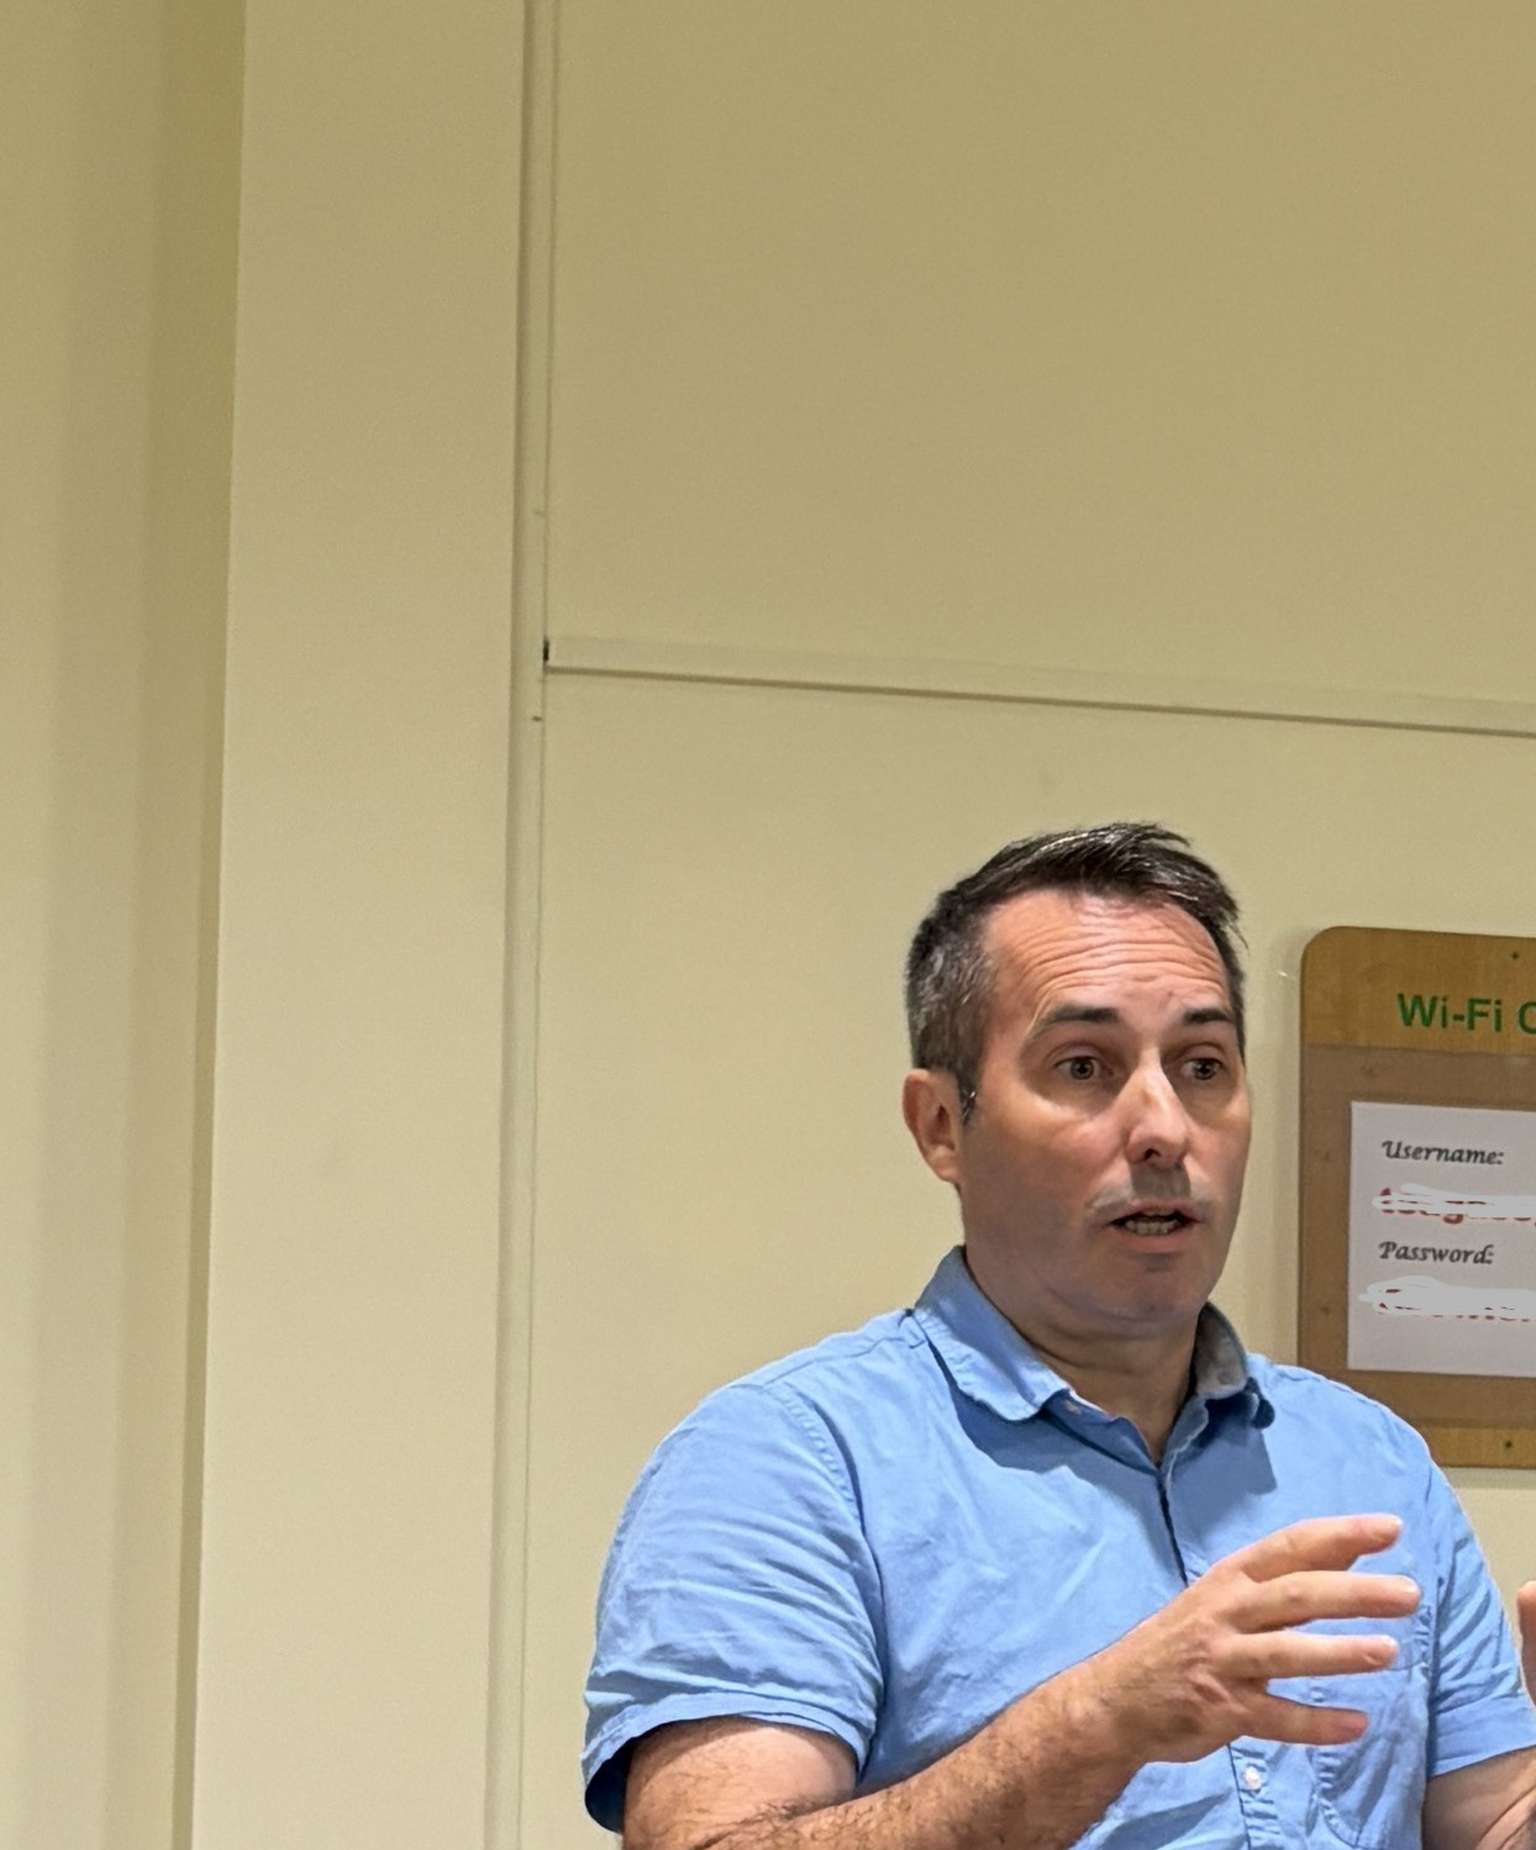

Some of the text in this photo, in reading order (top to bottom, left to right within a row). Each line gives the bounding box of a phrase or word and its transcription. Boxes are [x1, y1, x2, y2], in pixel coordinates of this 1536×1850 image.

[1397, 992, 1502, 1033] Wi-Fi
[1381, 1140, 1505, 1166] Username:
[1378, 1241, 1495, 1265] Password:
